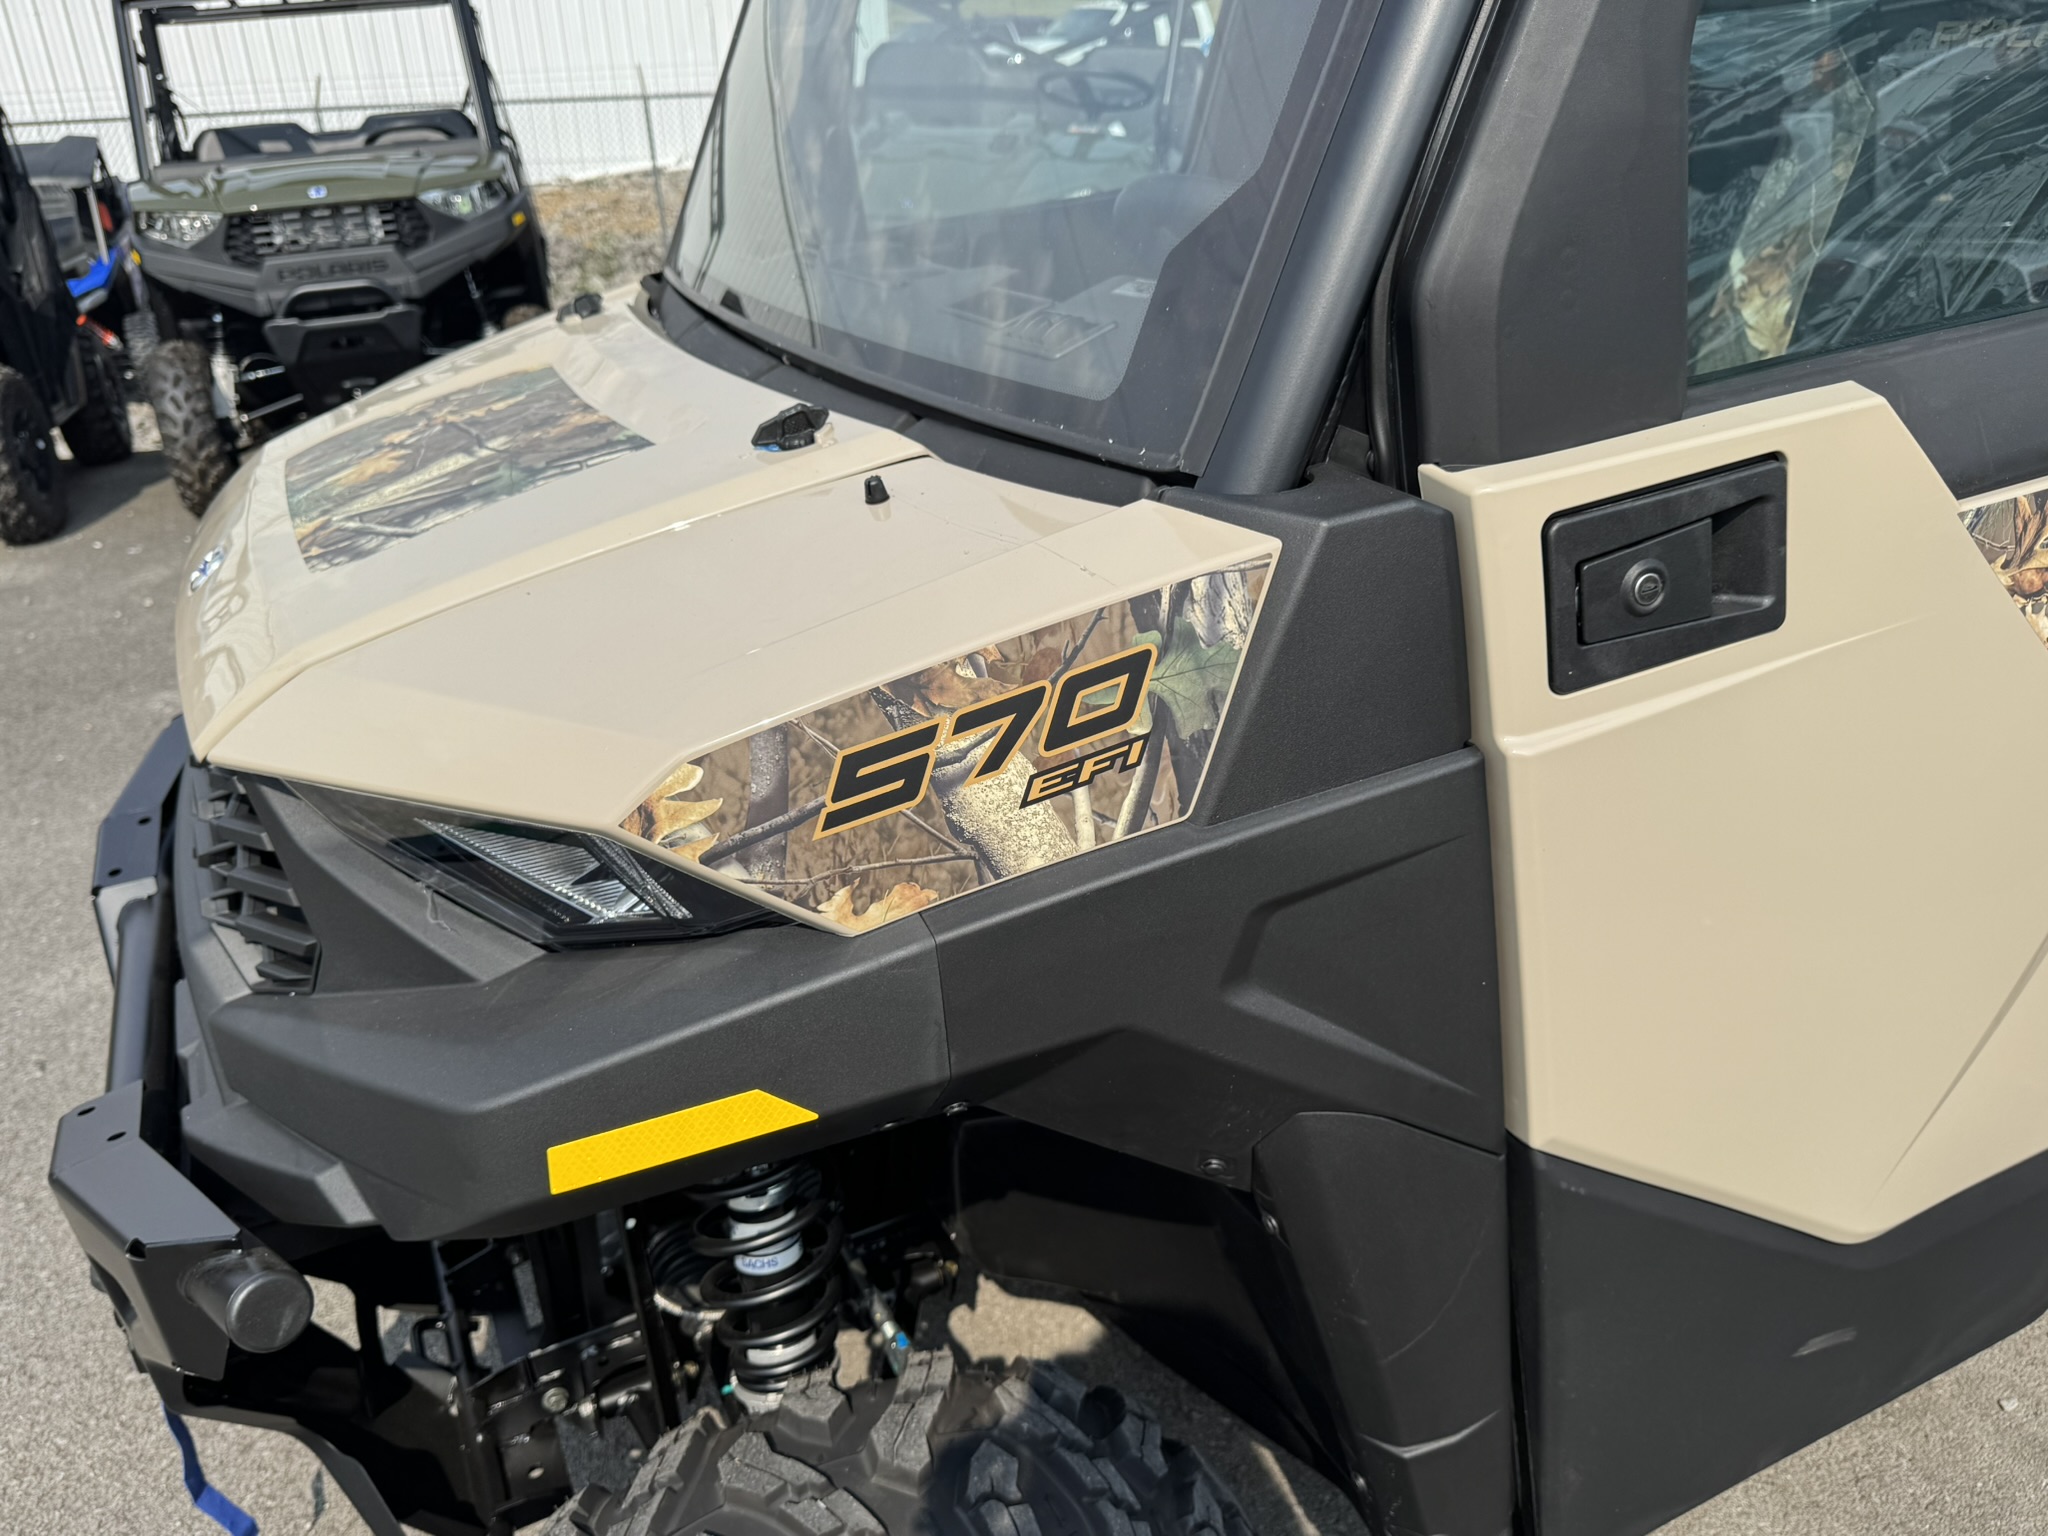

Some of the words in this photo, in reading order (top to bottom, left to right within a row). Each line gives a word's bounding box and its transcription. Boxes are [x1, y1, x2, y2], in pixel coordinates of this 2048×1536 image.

[277, 258, 390, 282] POLARIS
[812, 643, 1158, 840] 570
[1019, 732, 1150, 809] EFI
